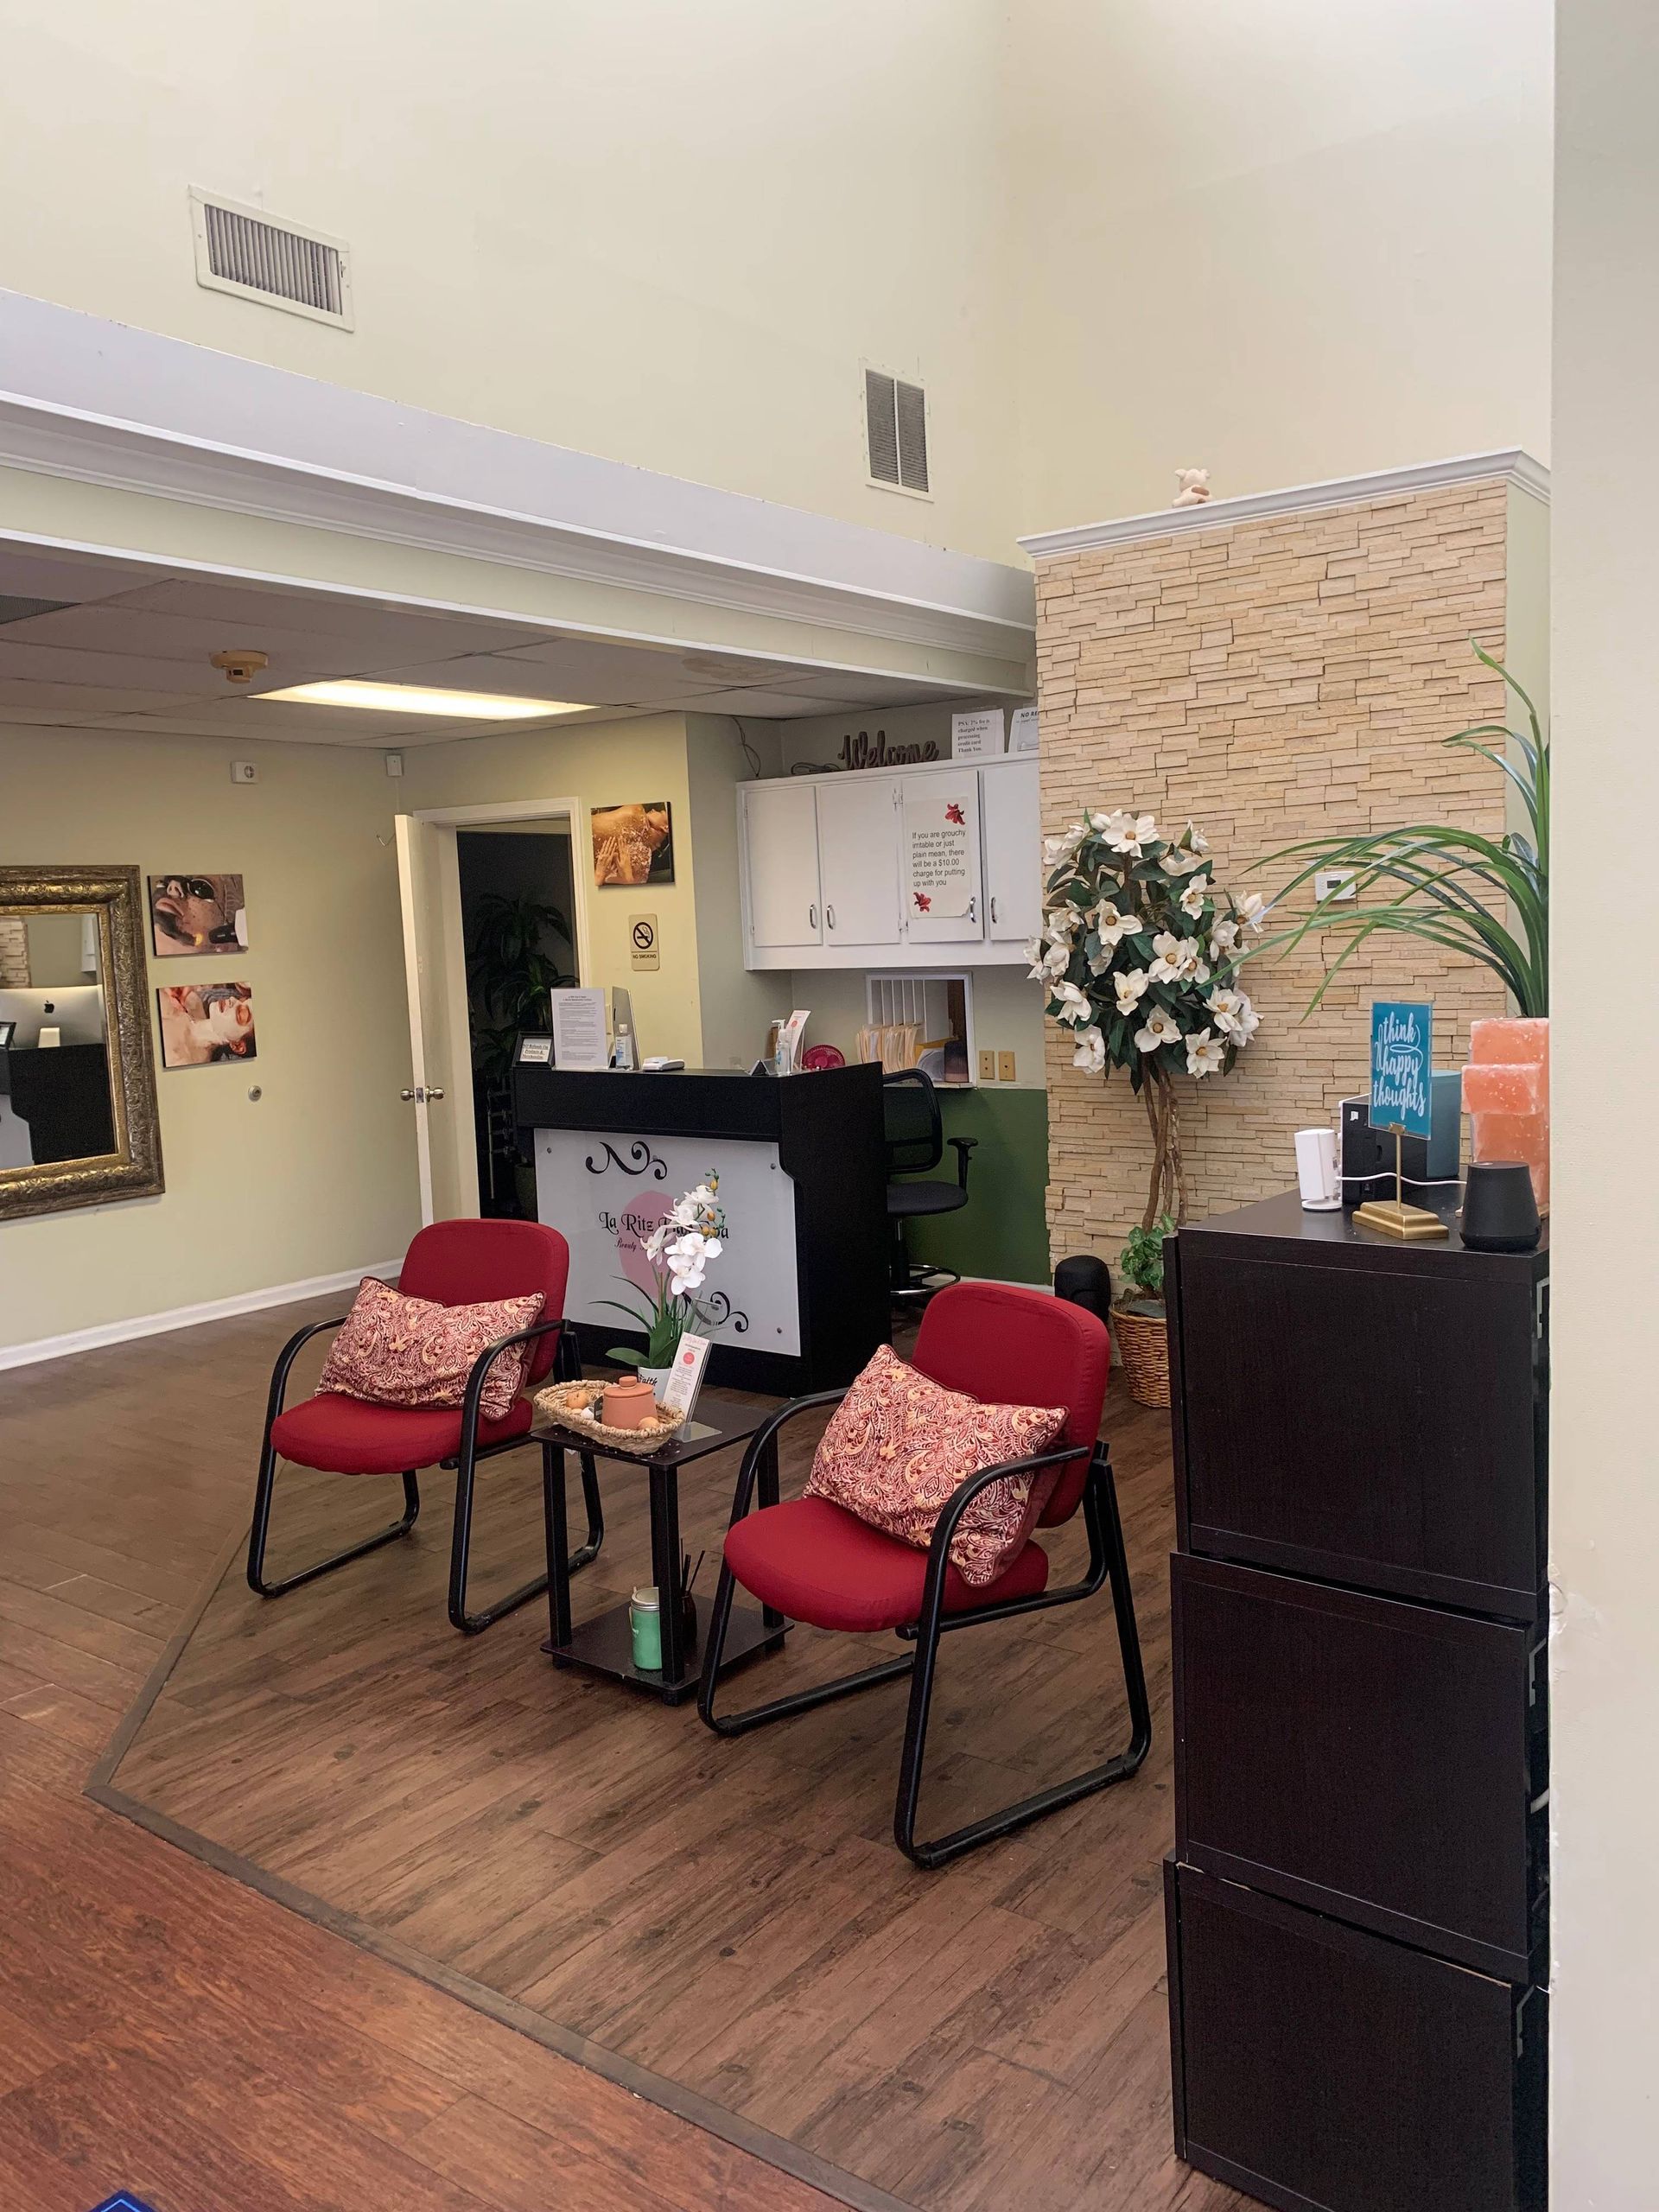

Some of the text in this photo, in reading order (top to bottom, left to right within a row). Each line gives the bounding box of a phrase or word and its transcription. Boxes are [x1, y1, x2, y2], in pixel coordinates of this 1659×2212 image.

[837, 730, 939, 770] Welcome
[941, 830, 966, 838] grouchy
[913, 851, 926, 859] plain
[938, 858, 959, 866] $10.00
[1383, 1011, 1418, 1046] think
[1380, 1045, 1421, 1090] happy
[1373, 1076, 1426, 1121] thoughts
[599, 1211, 619, 1235] La
[621, 1213, 654, 1238] Ritz
[639, 1374, 658, 1386] Faith
